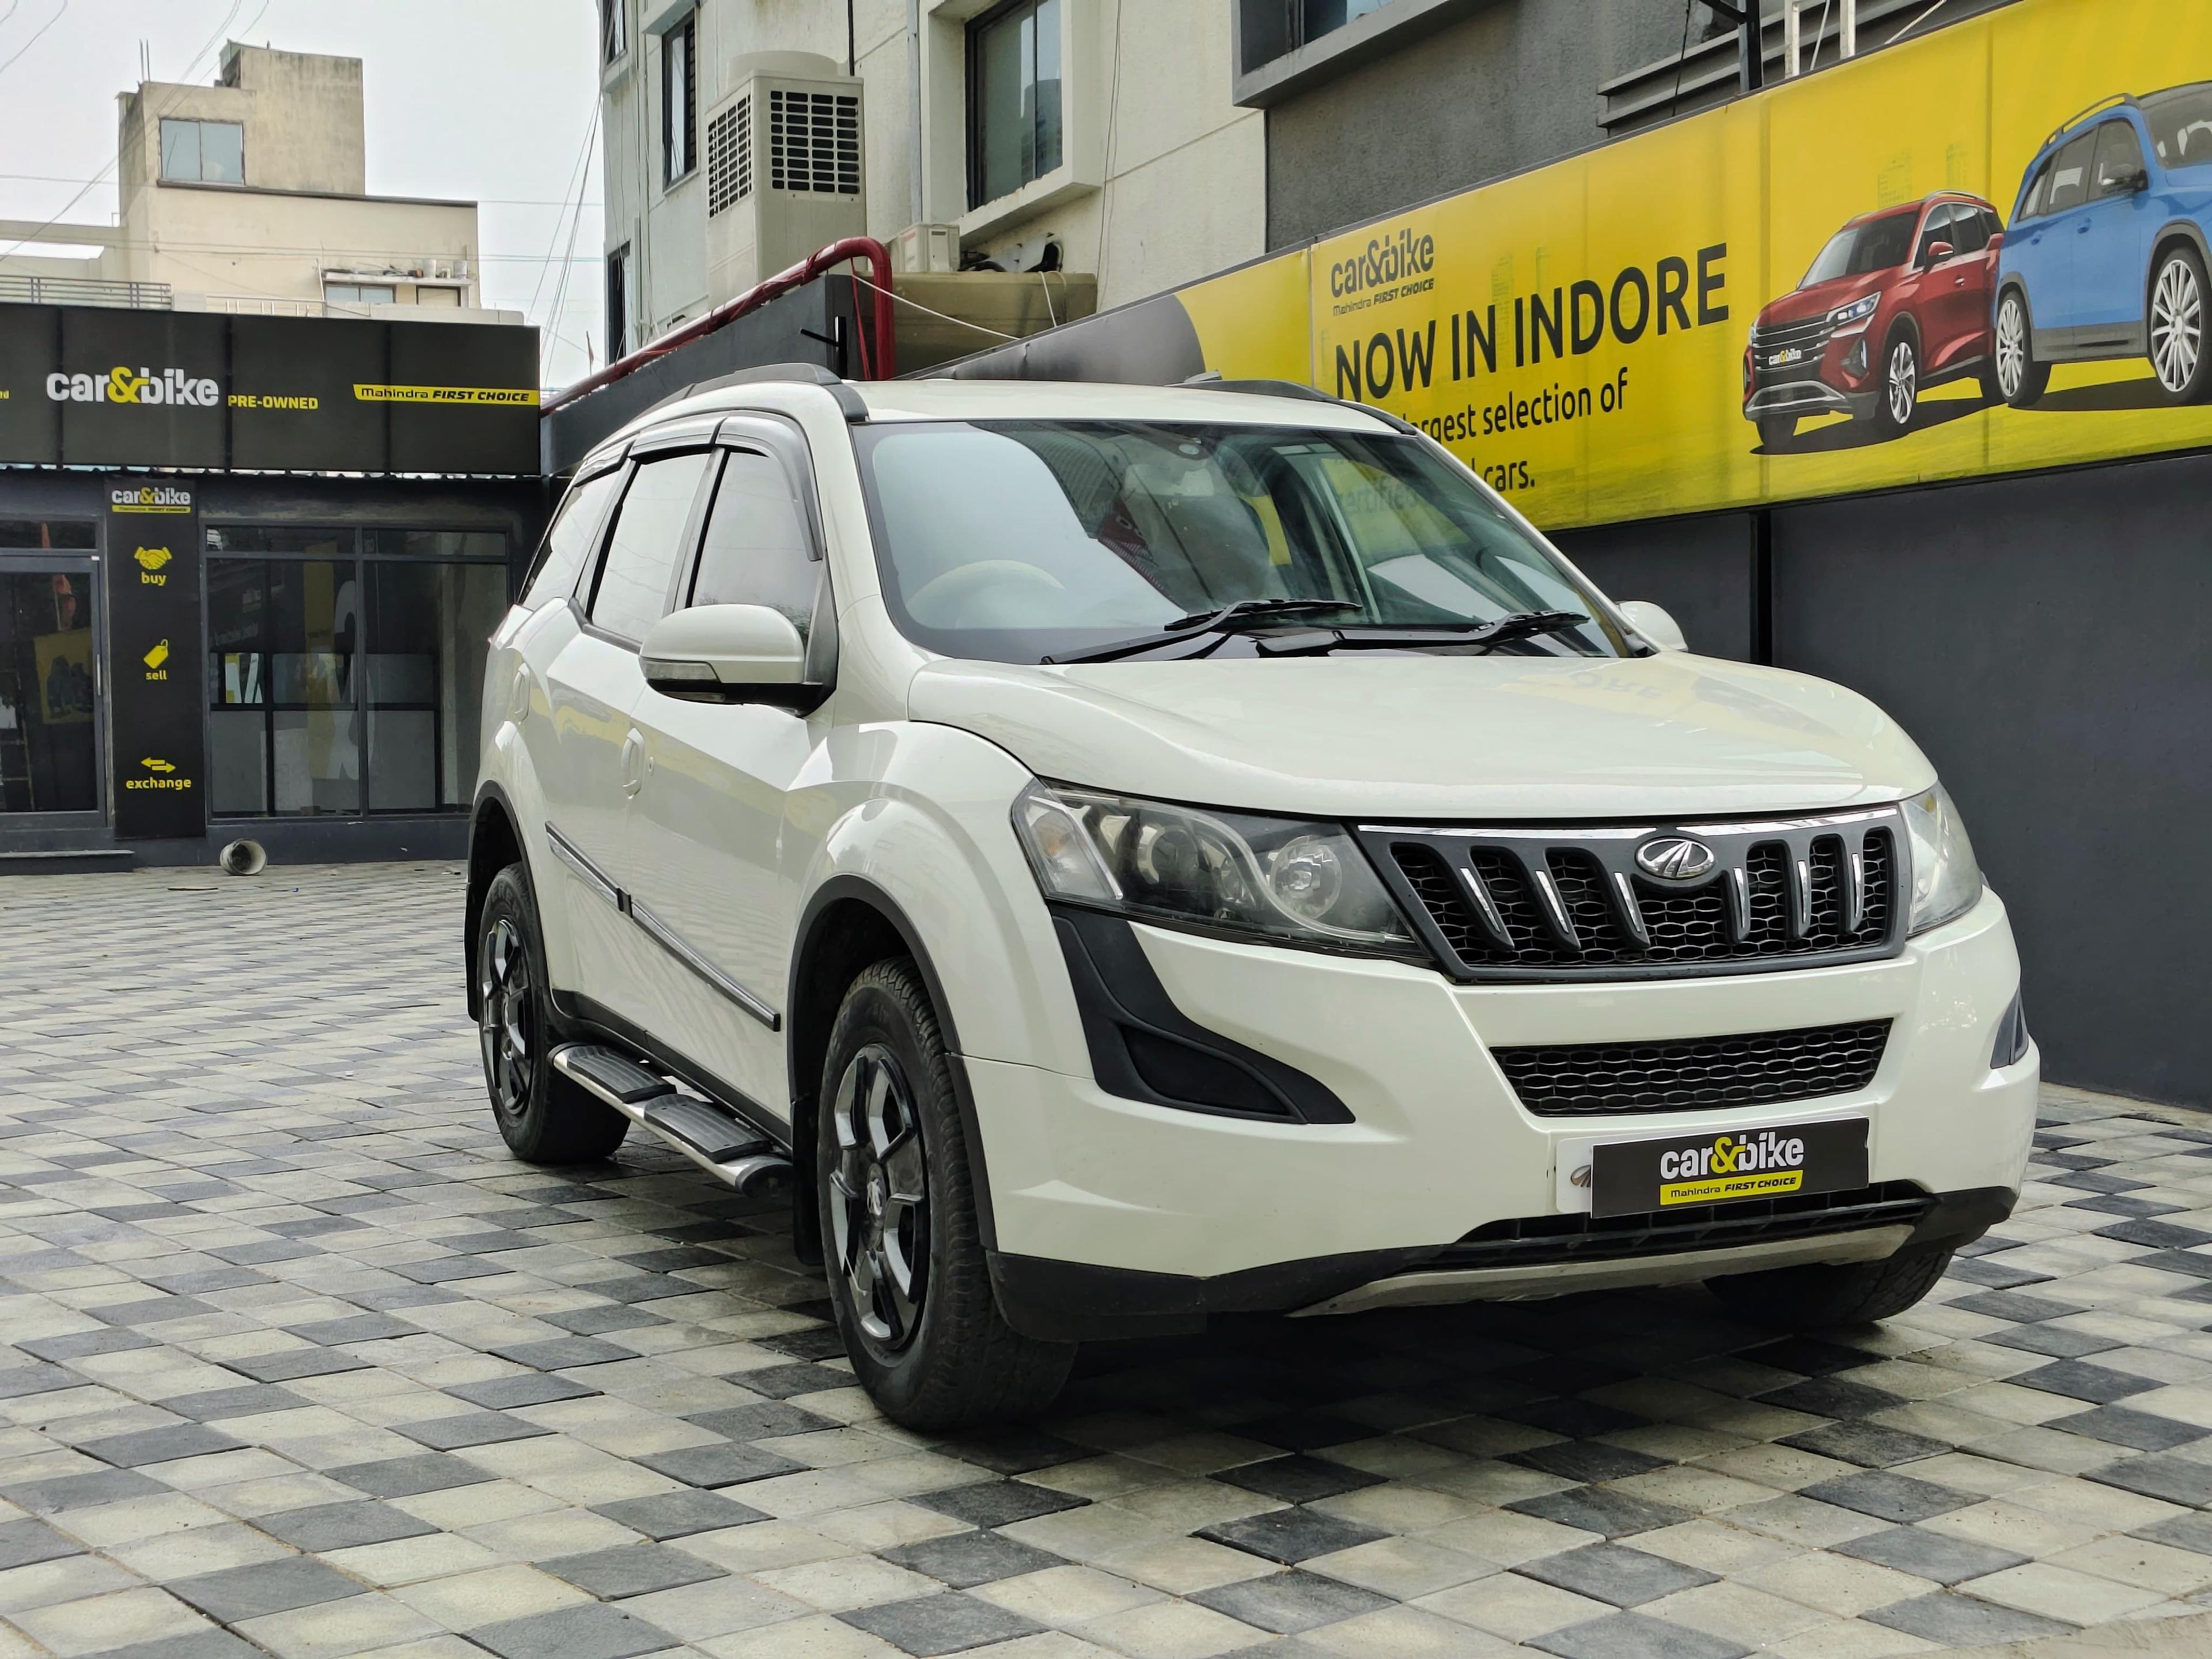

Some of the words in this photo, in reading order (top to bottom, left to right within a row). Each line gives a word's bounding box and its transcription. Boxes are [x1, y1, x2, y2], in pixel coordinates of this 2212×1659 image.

[1331, 228, 1434, 298] car&bike
[1373, 288, 1399, 305] FIRST
[1400, 278, 1434, 297] CHOICE
[1336, 320, 1436, 402] NOW
[1451, 305, 1497, 381] IN
[1514, 242, 1729, 367] INDORE
[47, 366, 219, 406] car&bike
[361, 388, 429, 399] Mahindra
[433, 390, 474, 400] FIRST
[477, 391, 529, 402] CHOICE
[228, 395, 319, 410] PRE-OWNED
[1483, 382, 1592, 436] selection
[1600, 366, 1628, 412] of
[1484, 460, 1536, 493] cars.
[112, 487, 191, 505] car&bike
[141, 572, 167, 586] buy
[146, 669, 167, 680] sell
[126, 776, 192, 790] exchange
[1660, 1131, 1804, 1180] car&bike
[1671, 1186, 1721, 1198] Mahindra
[1725, 1181, 1756, 1192] FIRST
[1758, 1177, 1796, 1188] CHOICE
